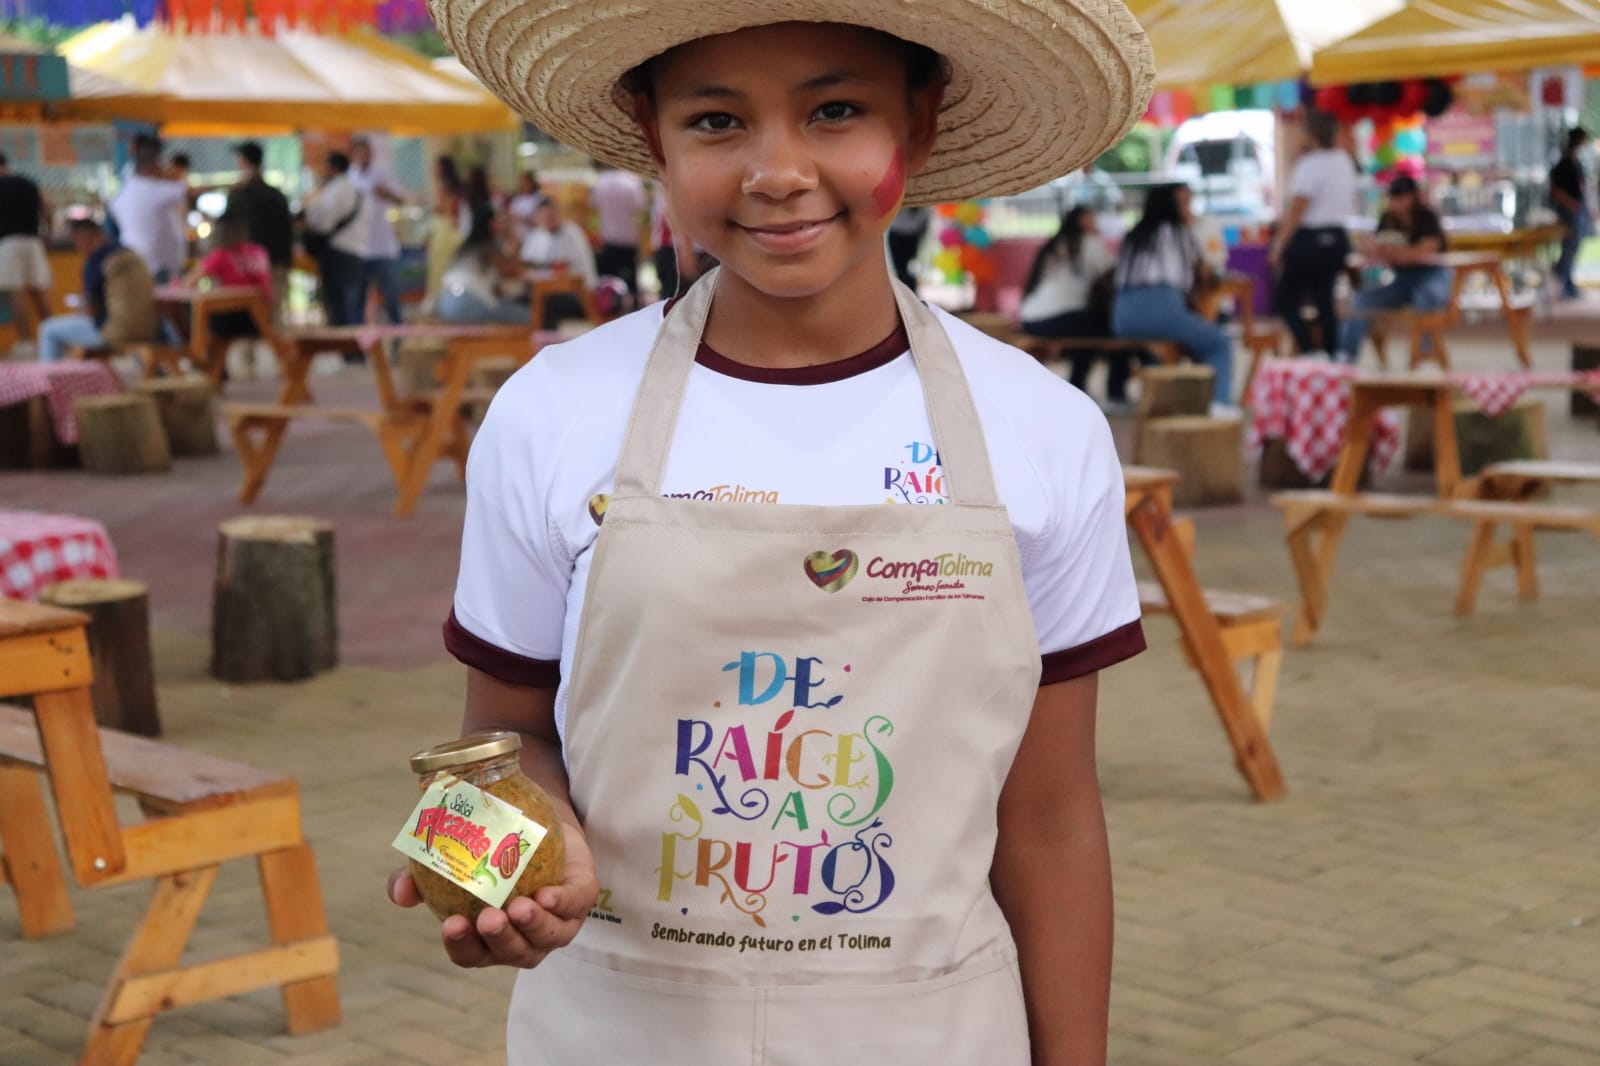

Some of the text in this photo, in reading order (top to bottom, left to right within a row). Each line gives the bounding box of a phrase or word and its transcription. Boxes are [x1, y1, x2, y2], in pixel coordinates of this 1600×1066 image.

[866, 552, 993, 582] ComfaTolima
[722, 651, 844, 708] DE
[675, 709, 894, 826] RAÍCES
[449, 793, 474, 818] Salsa
[771, 791, 809, 831] A
[654, 800, 896, 920] FRUTOS
[651, 923, 891, 952] Sembrando futuro en el Tolima
